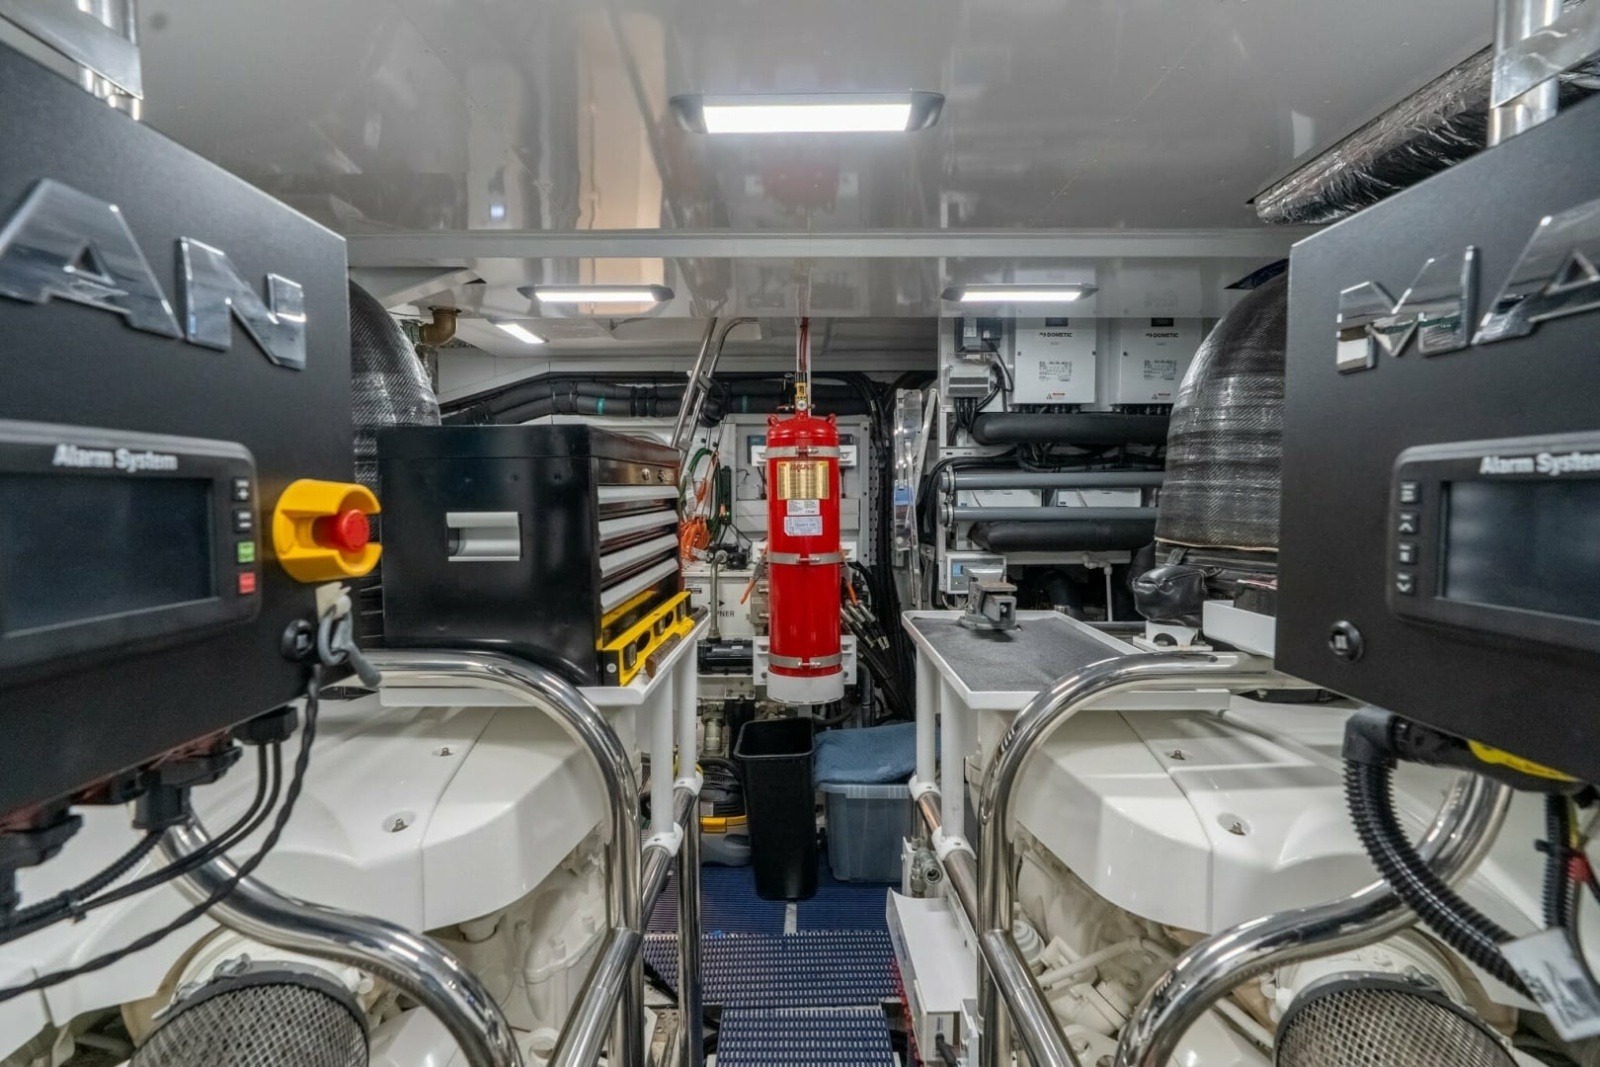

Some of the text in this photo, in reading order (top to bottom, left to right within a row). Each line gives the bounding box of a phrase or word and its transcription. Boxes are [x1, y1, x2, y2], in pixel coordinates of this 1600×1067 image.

[52, 444, 178, 473] Alarm System
[1479, 456, 1535, 475] Alarm
